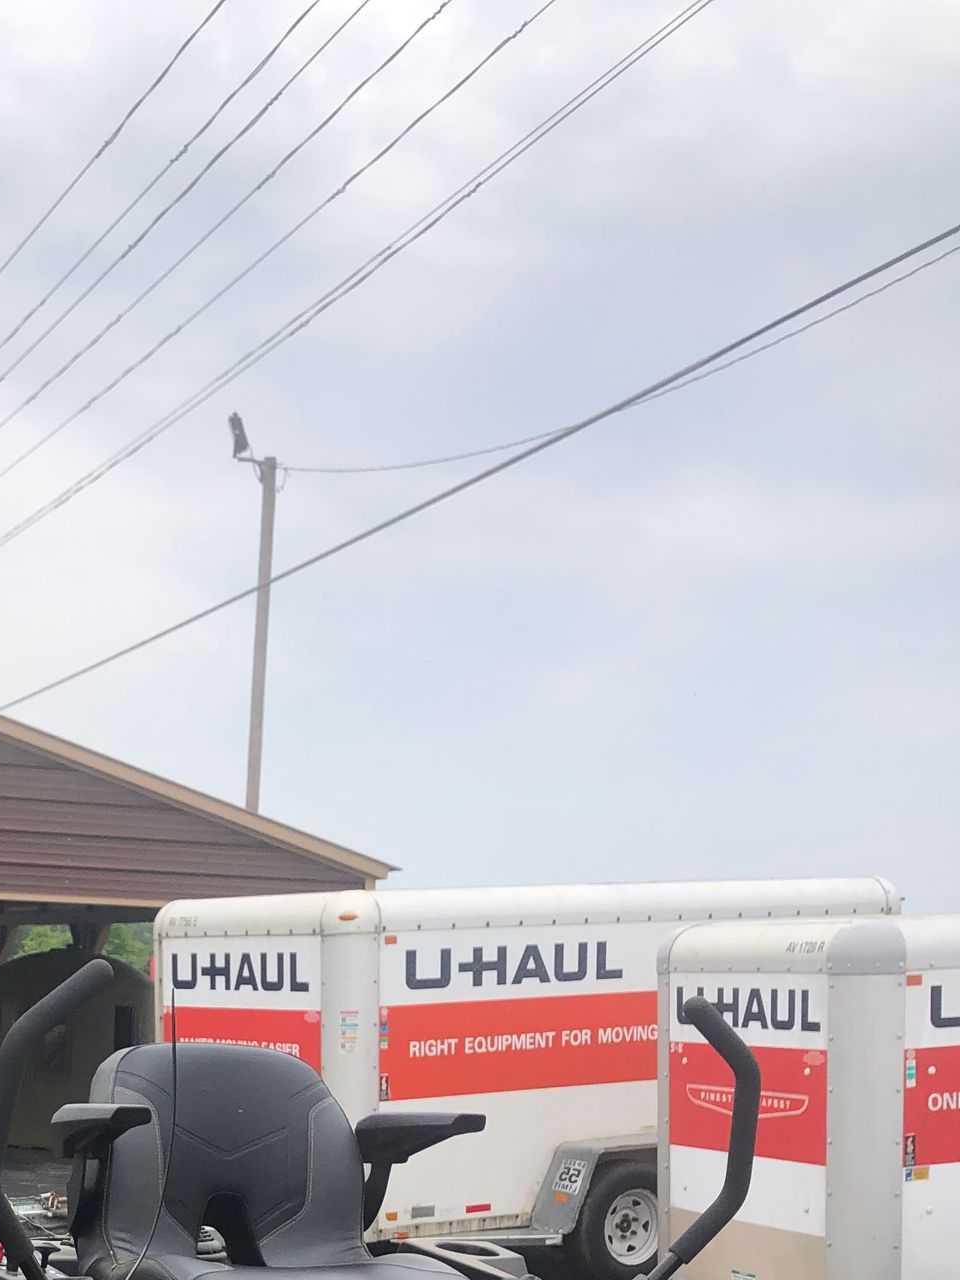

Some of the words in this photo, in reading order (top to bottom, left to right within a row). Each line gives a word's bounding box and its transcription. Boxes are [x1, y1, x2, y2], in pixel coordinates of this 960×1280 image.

[172, 952, 309, 992] U-HAUL
[405, 941, 623, 990] U-HAUL
[409, 1038, 458, 1058] RIGHT
[465, 1031, 556, 1054] EQUIPMENT
[562, 1028, 591, 1046] FOR
[598, 1023, 658, 1044] MOVING
[761, 1097, 791, 1109] AFEST
[927, 1092, 960, 1112] ON
